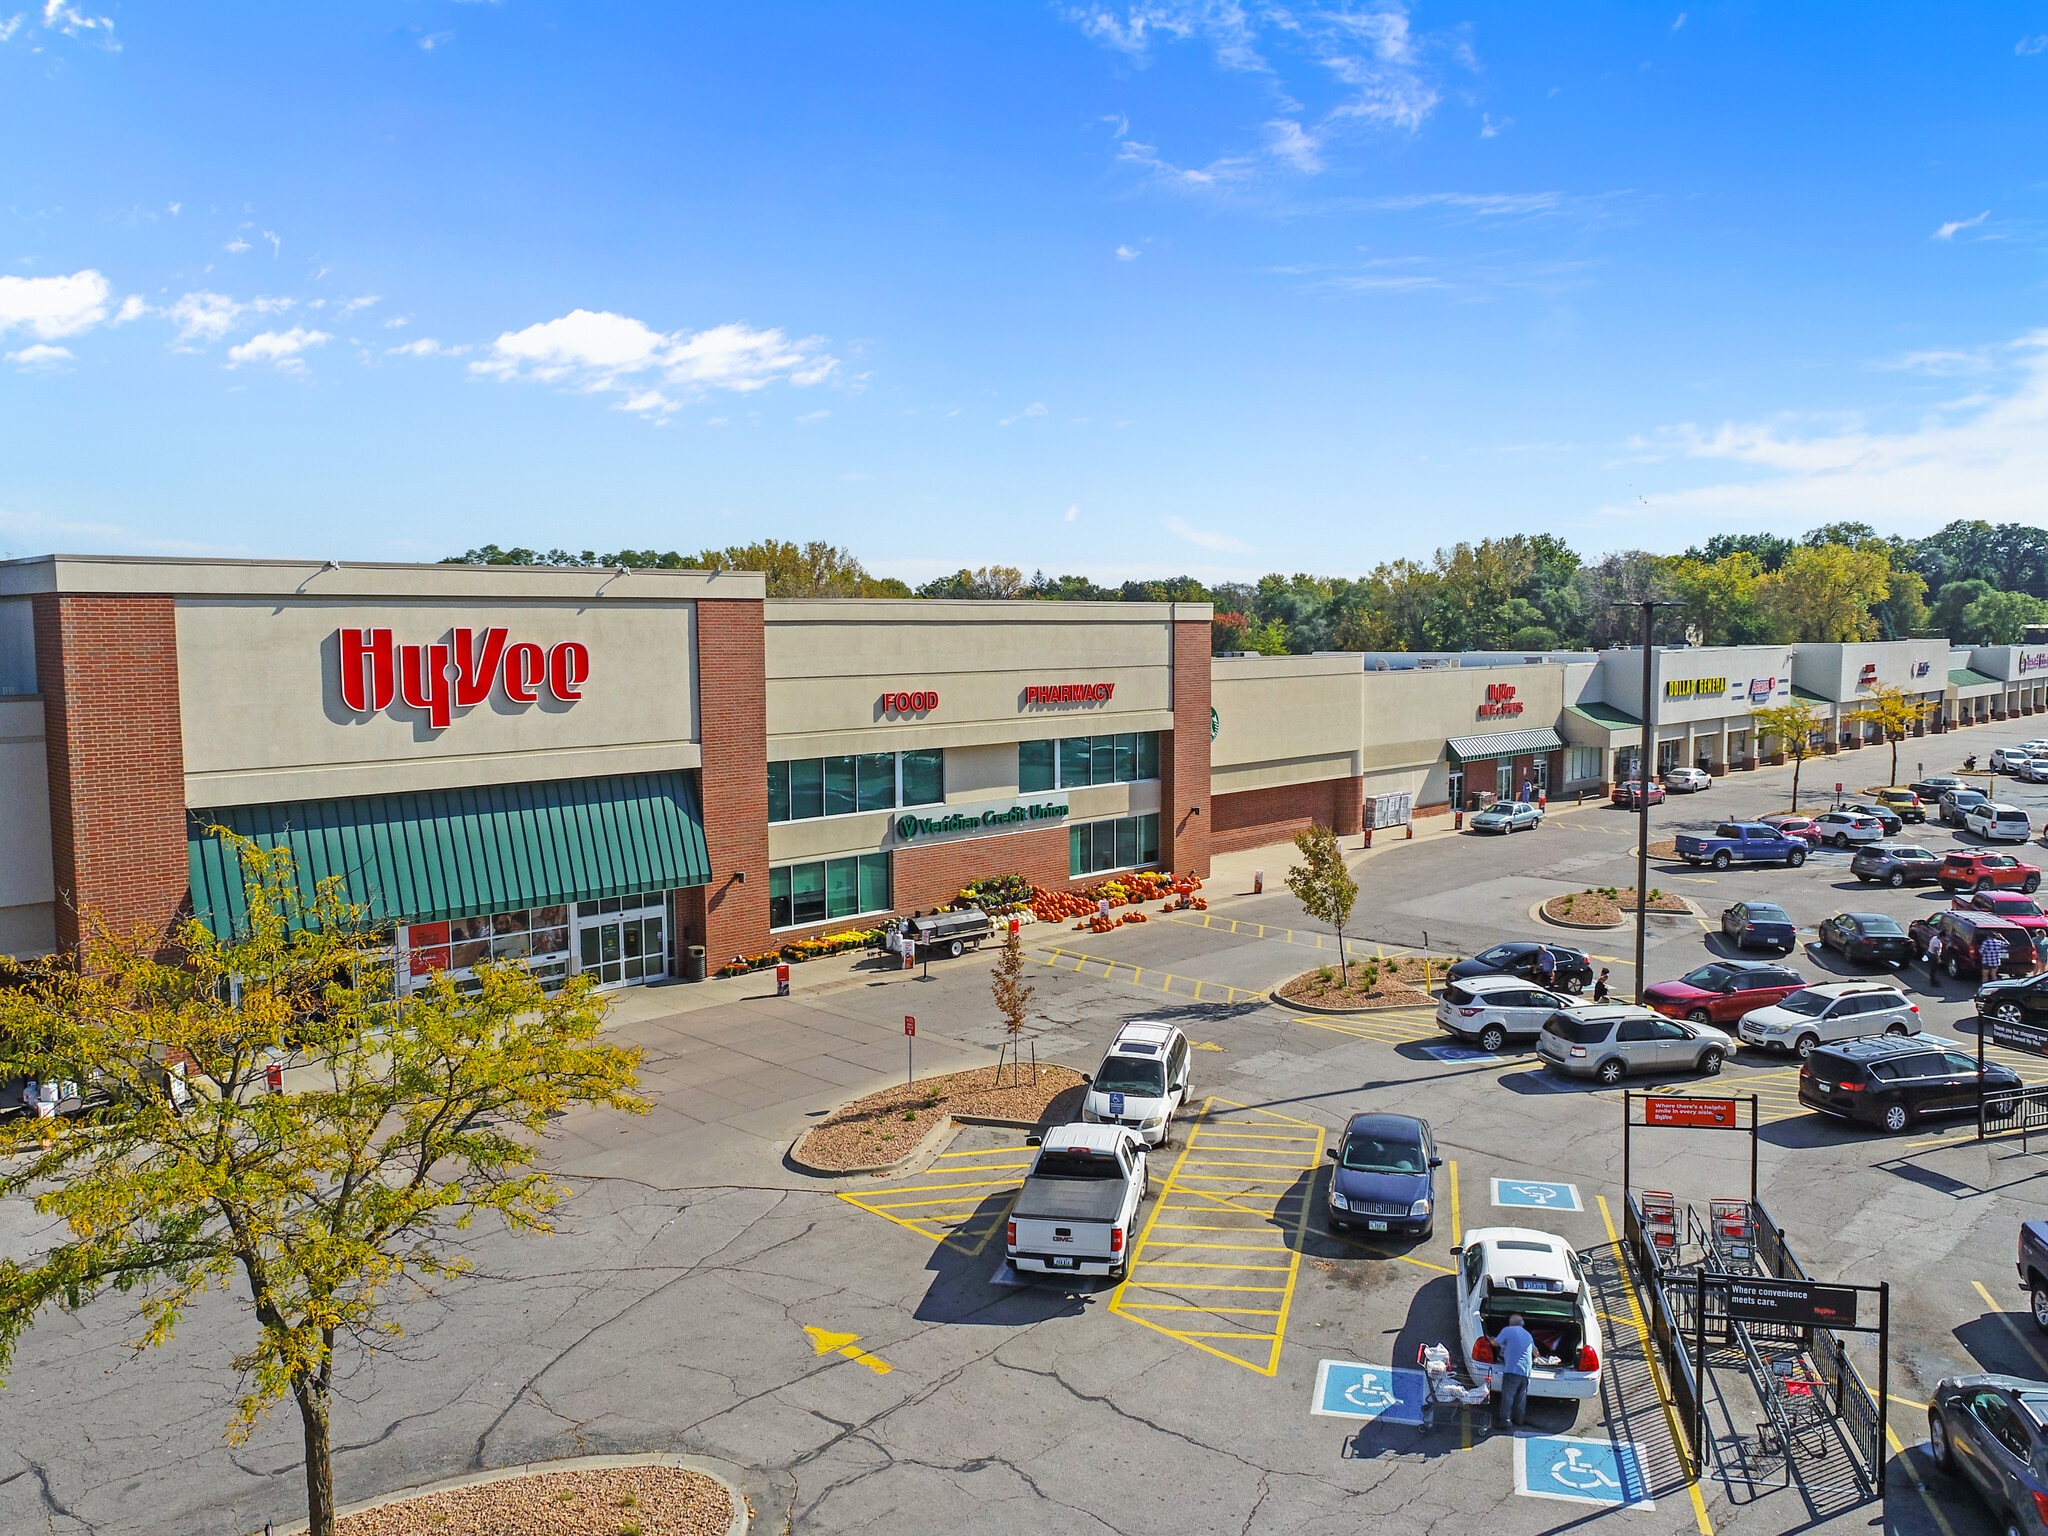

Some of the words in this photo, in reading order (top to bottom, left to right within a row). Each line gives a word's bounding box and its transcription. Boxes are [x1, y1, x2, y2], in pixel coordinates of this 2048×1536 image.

[339, 627, 590, 729] HyVee
[1667, 679, 1695, 696] DOLLAR
[1697, 678, 1727, 694] GENERAL
[883, 690, 939, 713] FOOD
[1025, 682, 1116, 704] PHARMACY
[920, 813, 981, 834] Veridian
[983, 806, 1028, 826] Credit
[1030, 802, 1069, 820] Union
[1732, 1285, 1756, 1295] Where
[1758, 1288, 1808, 1299] convenience
[1732, 1296, 1755, 1305] meets
[1757, 1297, 1777, 1307] care.
